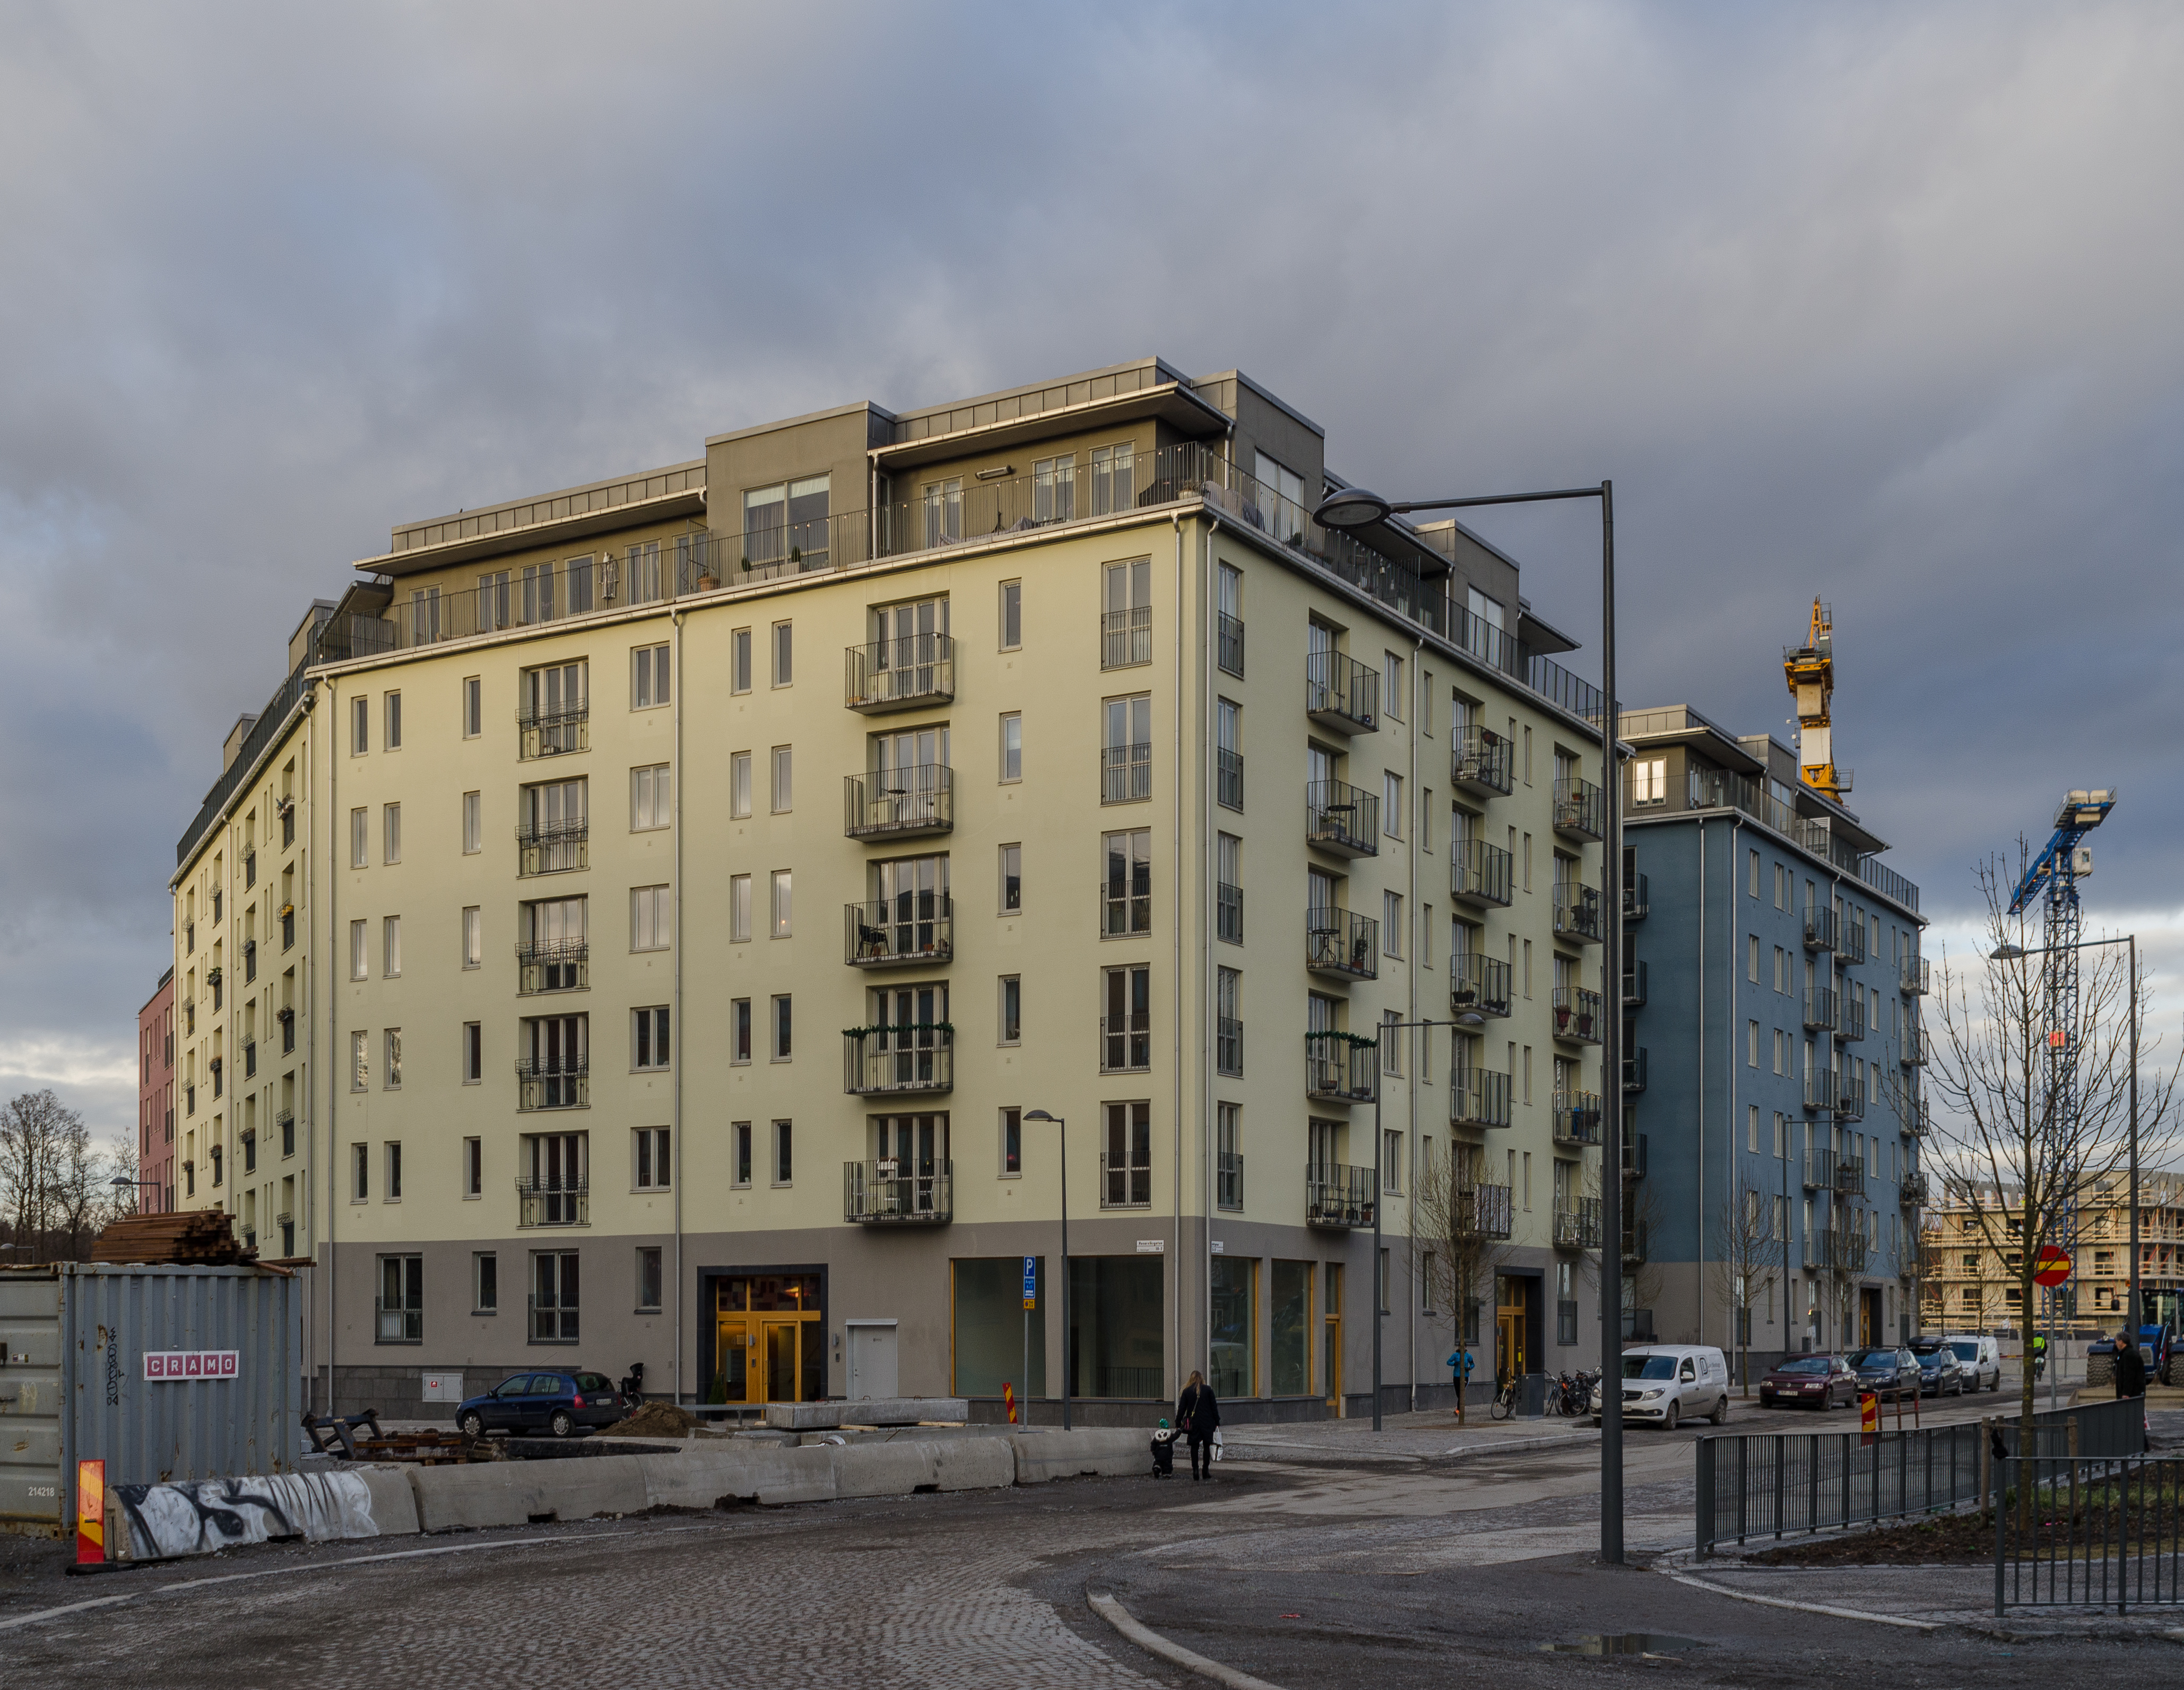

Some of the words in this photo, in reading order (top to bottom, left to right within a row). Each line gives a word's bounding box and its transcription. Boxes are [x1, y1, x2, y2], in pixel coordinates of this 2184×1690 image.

[1026, 1259, 1033, 1275] P
[151, 1358, 232, 1373] CRAMO
[28, 1486, 55, 1497] 214218
